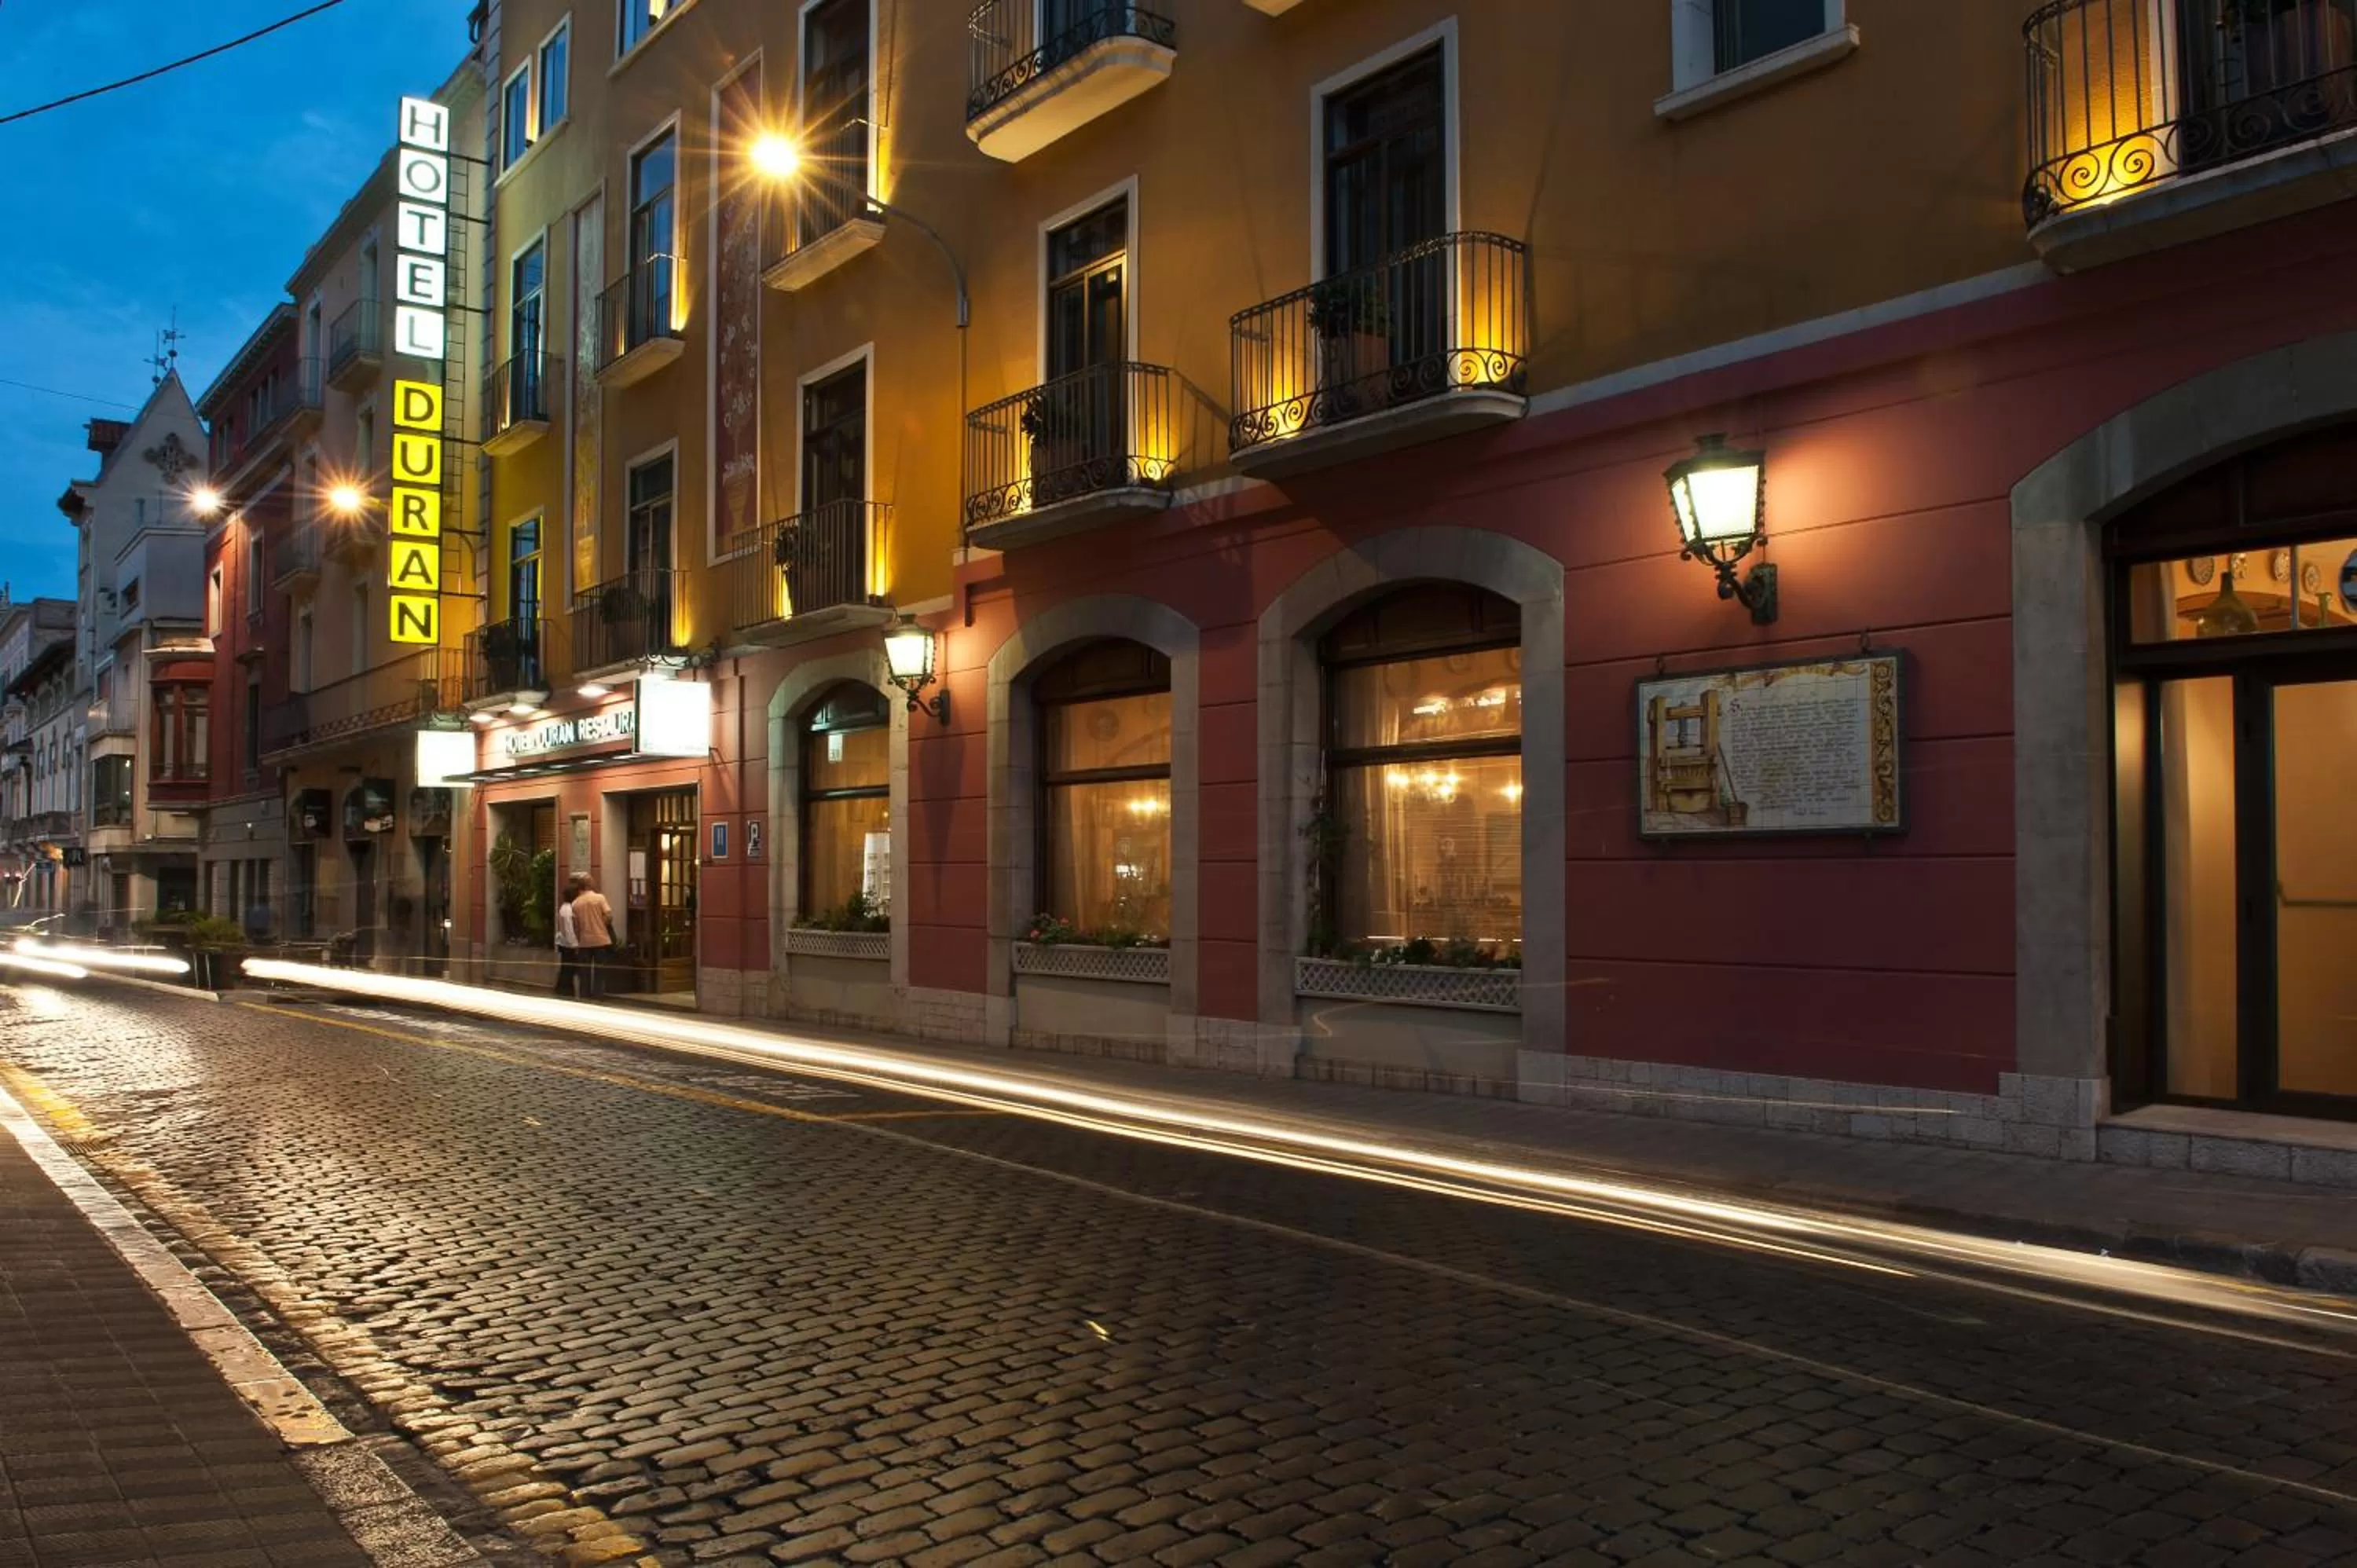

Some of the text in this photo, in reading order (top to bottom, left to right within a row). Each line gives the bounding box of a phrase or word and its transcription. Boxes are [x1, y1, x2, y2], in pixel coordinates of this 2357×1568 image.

[398, 105, 442, 638] HOTEL DURAN
[537, 721, 574, 747] DURAN
